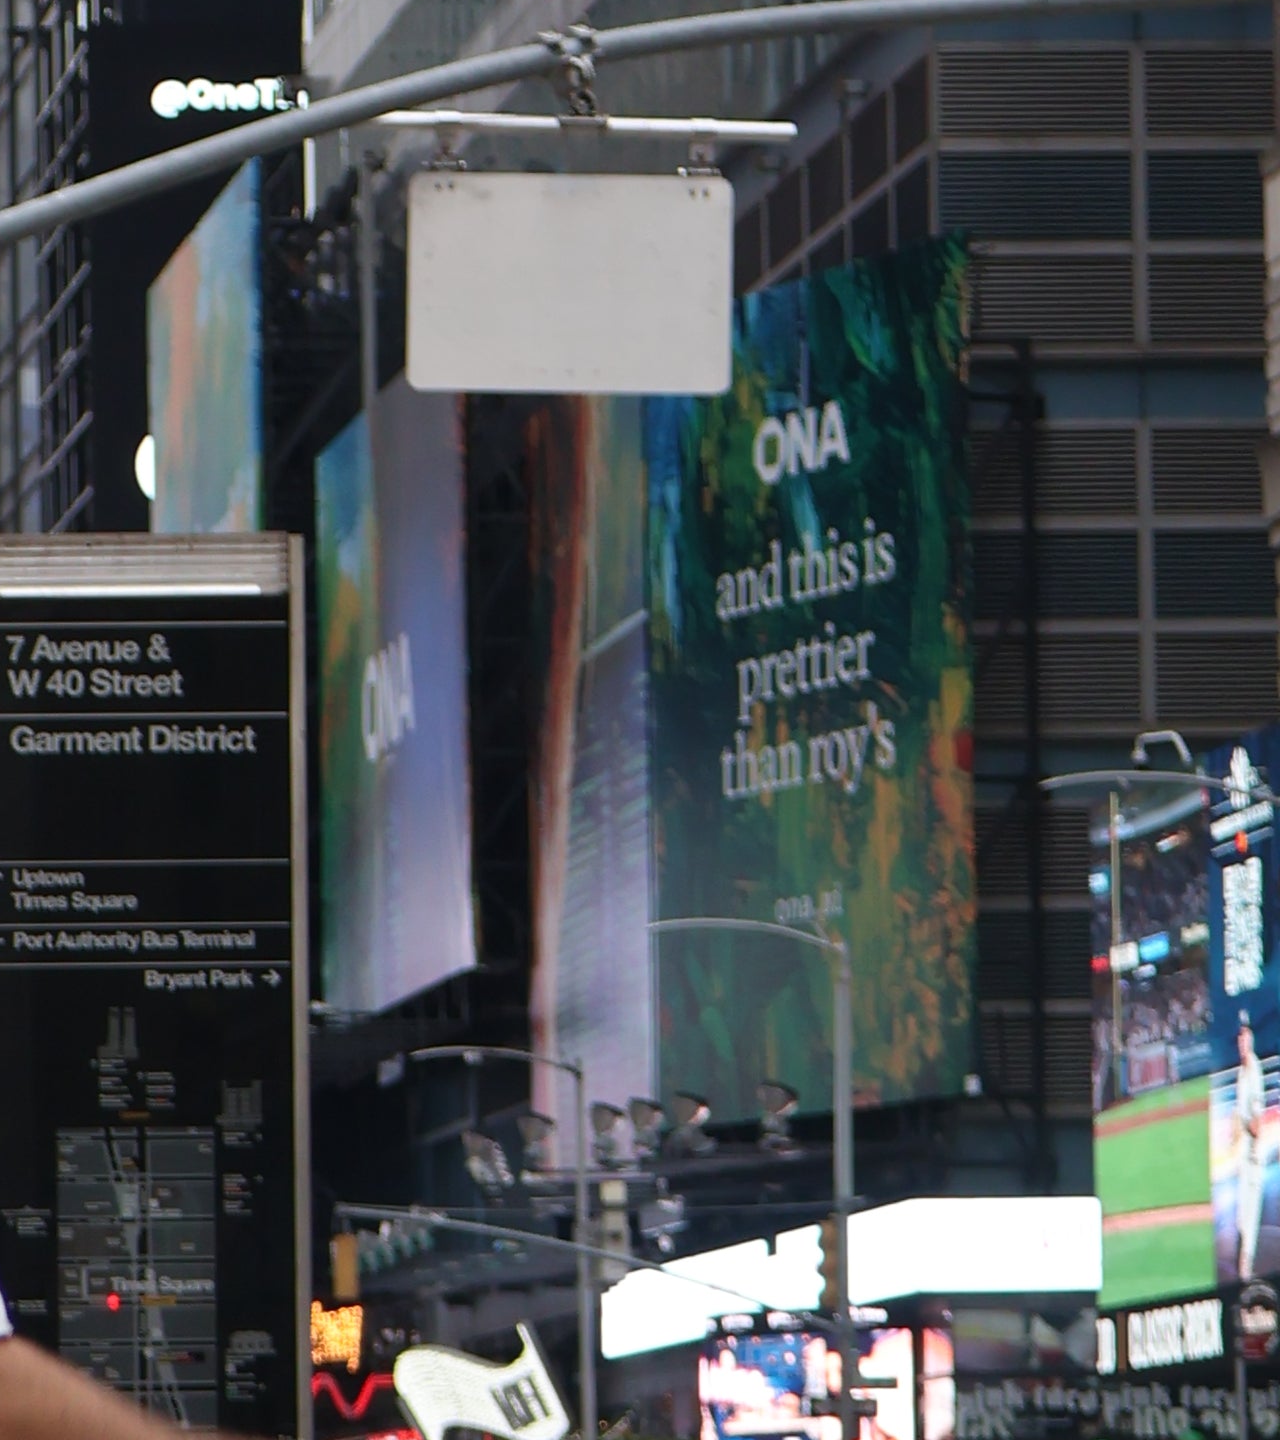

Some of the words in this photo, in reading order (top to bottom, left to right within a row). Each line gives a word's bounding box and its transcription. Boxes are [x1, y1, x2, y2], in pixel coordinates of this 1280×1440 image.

[752, 400, 851, 485] ONA
[716, 539, 783, 622] and
[788, 526, 859, 604] this
[863, 516, 897, 586] is
[6, 635, 25, 661] 7
[30, 634, 140, 662] Avenue
[147, 633, 171, 662] &
[7, 669, 41, 697] W
[45, 669, 85, 697] 40
[90, 668, 184, 697] Street
[737, 621, 876, 723] prettier
[361, 631, 416, 761] ONA
[9, 724, 143, 754] Garment
[147, 724, 257, 754] District
[722, 730, 803, 801] than
[808, 700, 896, 794] roy's
[12, 868, 85, 890] Uptown
[10, 891, 69, 911] Times
[71, 891, 138, 913] Square
[13, 931, 53, 950] Port
[55, 930, 140, 953] Authority
[142, 930, 178, 949] Bus
[179, 929, 256, 949] Terminal
[144, 969, 207, 992] Bryant
[209, 969, 254, 988] Park
